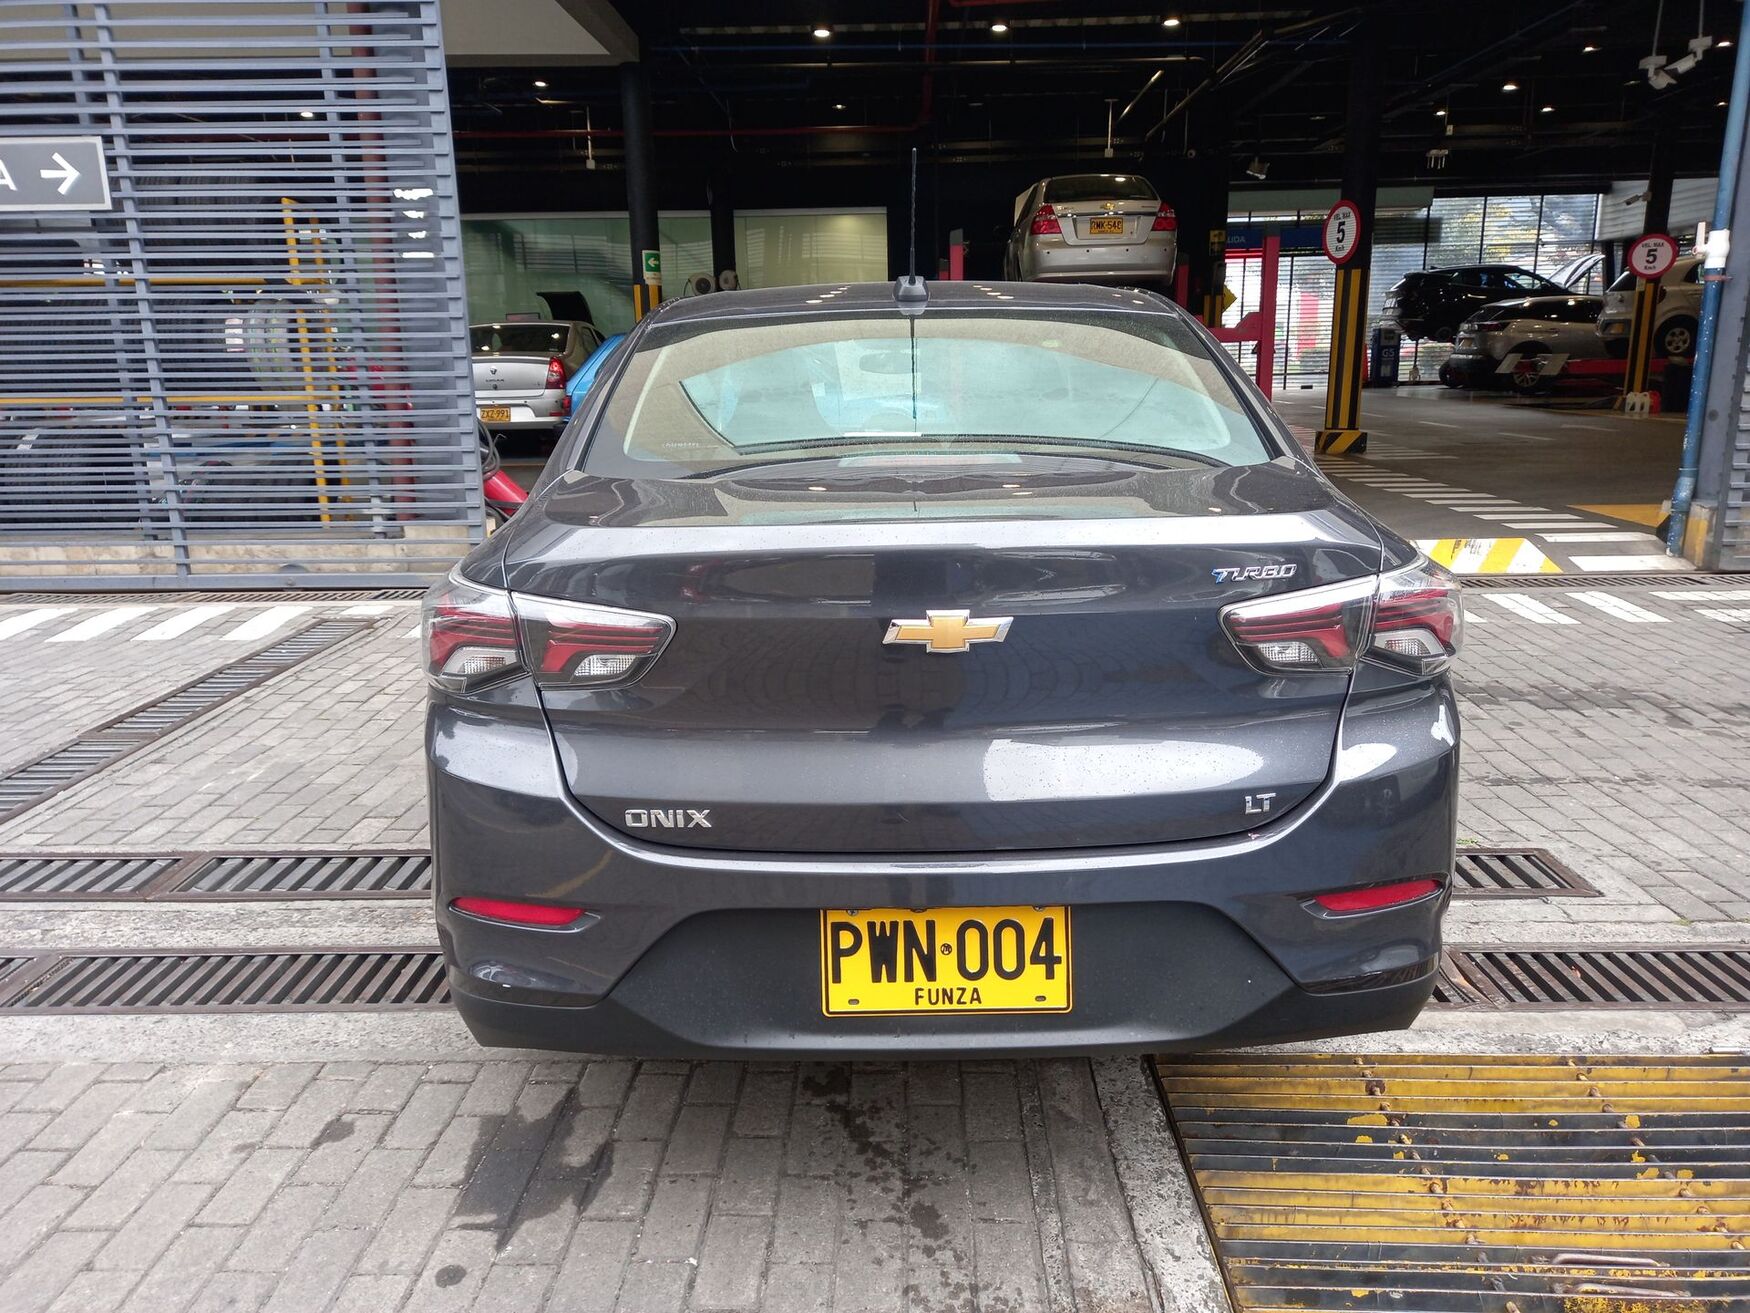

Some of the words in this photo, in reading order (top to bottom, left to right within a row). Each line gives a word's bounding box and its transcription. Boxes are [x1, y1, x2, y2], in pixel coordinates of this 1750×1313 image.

[1336, 221, 1346, 243] 5
[1645, 248, 1658, 264] 5
[1211, 563, 1297, 584] TURBO
[1245, 792, 1277, 815] LT
[624, 809, 712, 828] ONIX
[914, 986, 983, 1006] FUNZA
